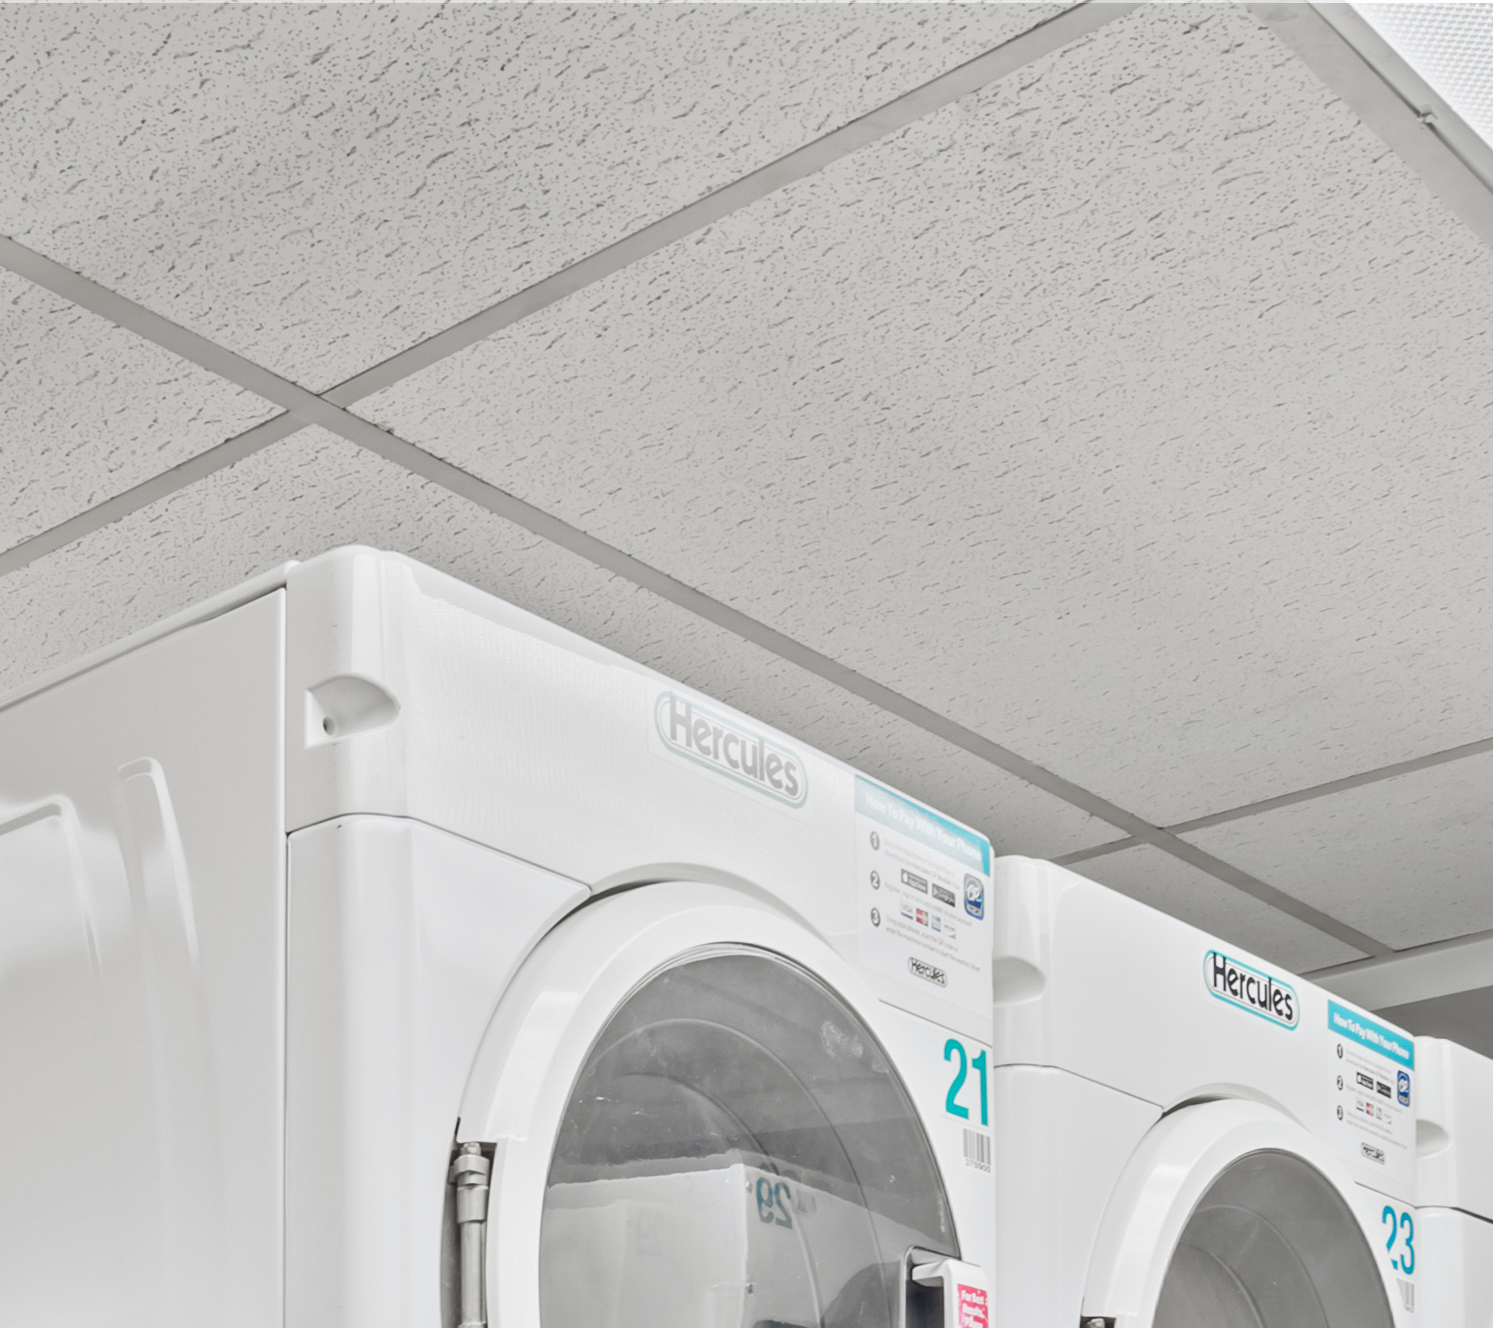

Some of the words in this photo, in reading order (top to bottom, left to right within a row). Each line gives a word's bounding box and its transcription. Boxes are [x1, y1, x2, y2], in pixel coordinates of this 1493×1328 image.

[669, 693, 799, 797] Hercules
[957, 835, 982, 862] Phone
[1213, 953, 1293, 1021] Hercules
[944, 1038, 989, 1127] 21
[1381, 1205, 1415, 1275] 23
